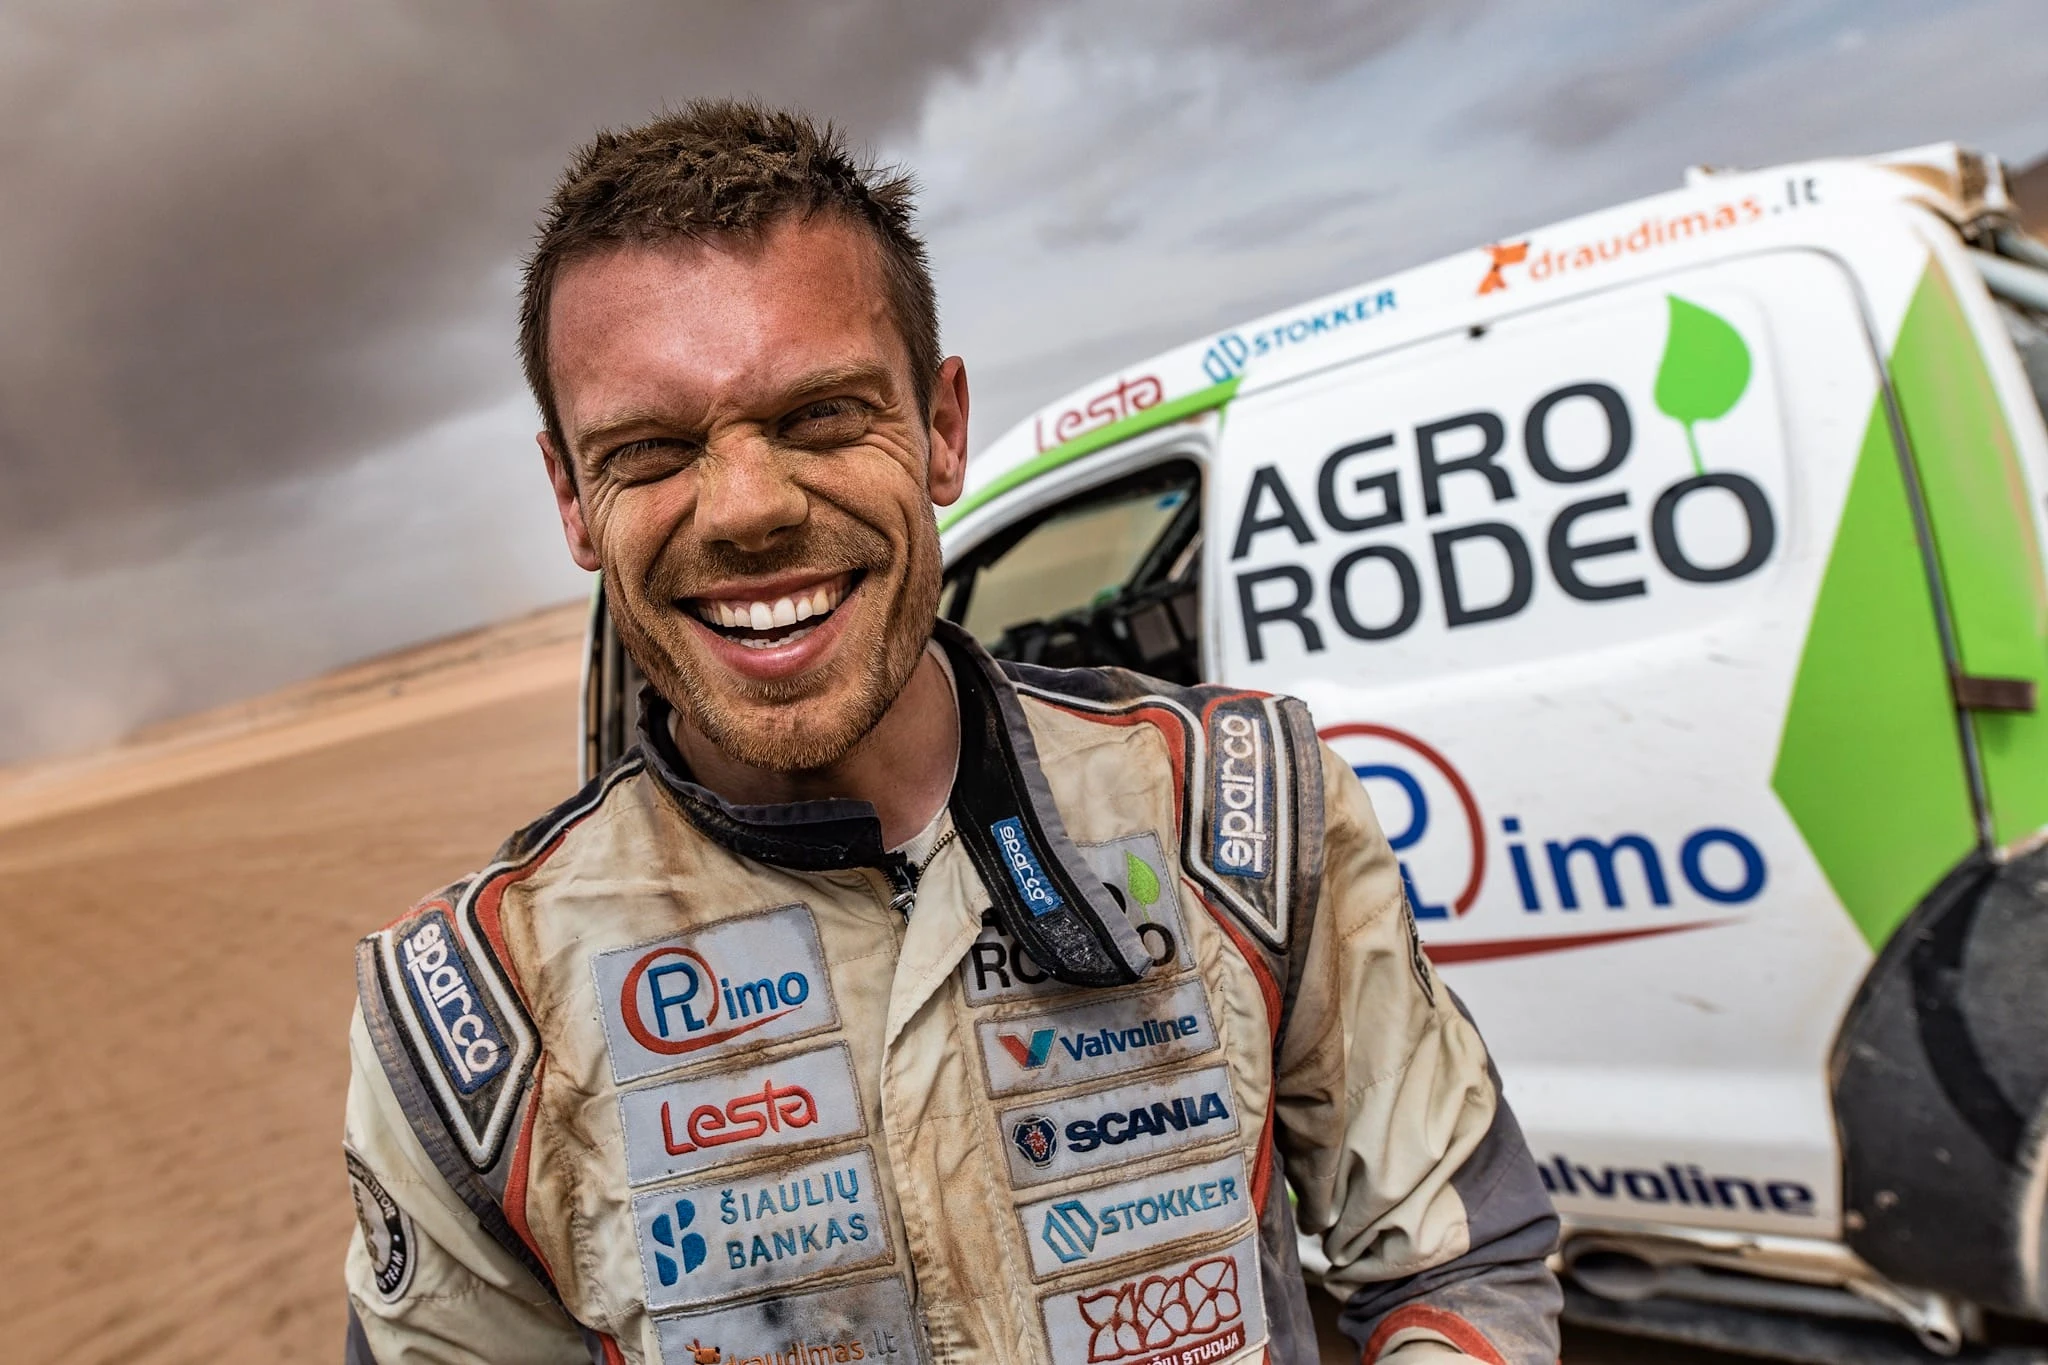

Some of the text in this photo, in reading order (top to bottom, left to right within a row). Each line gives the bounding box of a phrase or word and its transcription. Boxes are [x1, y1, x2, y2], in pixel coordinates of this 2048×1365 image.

[1529, 176, 1819, 280] draudimas.lt
[1254, 289, 1397, 356] STOKKER
[1034, 376, 1162, 454] Lesta
[1230, 383, 1632, 560] AGRO
[1235, 473, 1776, 663] RODEO
[1219, 713, 1265, 874] sparco
[403, 923, 497, 1085] sparco
[648, 962, 809, 1038] Rimo
[1058, 1012, 1199, 1062] Valvoline
[661, 1079, 818, 1157] Lesta
[1065, 1092, 1230, 1154] SCANIA
[720, 1168, 860, 1226] ŠIAULIŲ
[1098, 1175, 1239, 1236] STOKKER
[727, 1212, 870, 1271] BANKAS
[1182, 1332, 1239, 1365] STUDIJA
